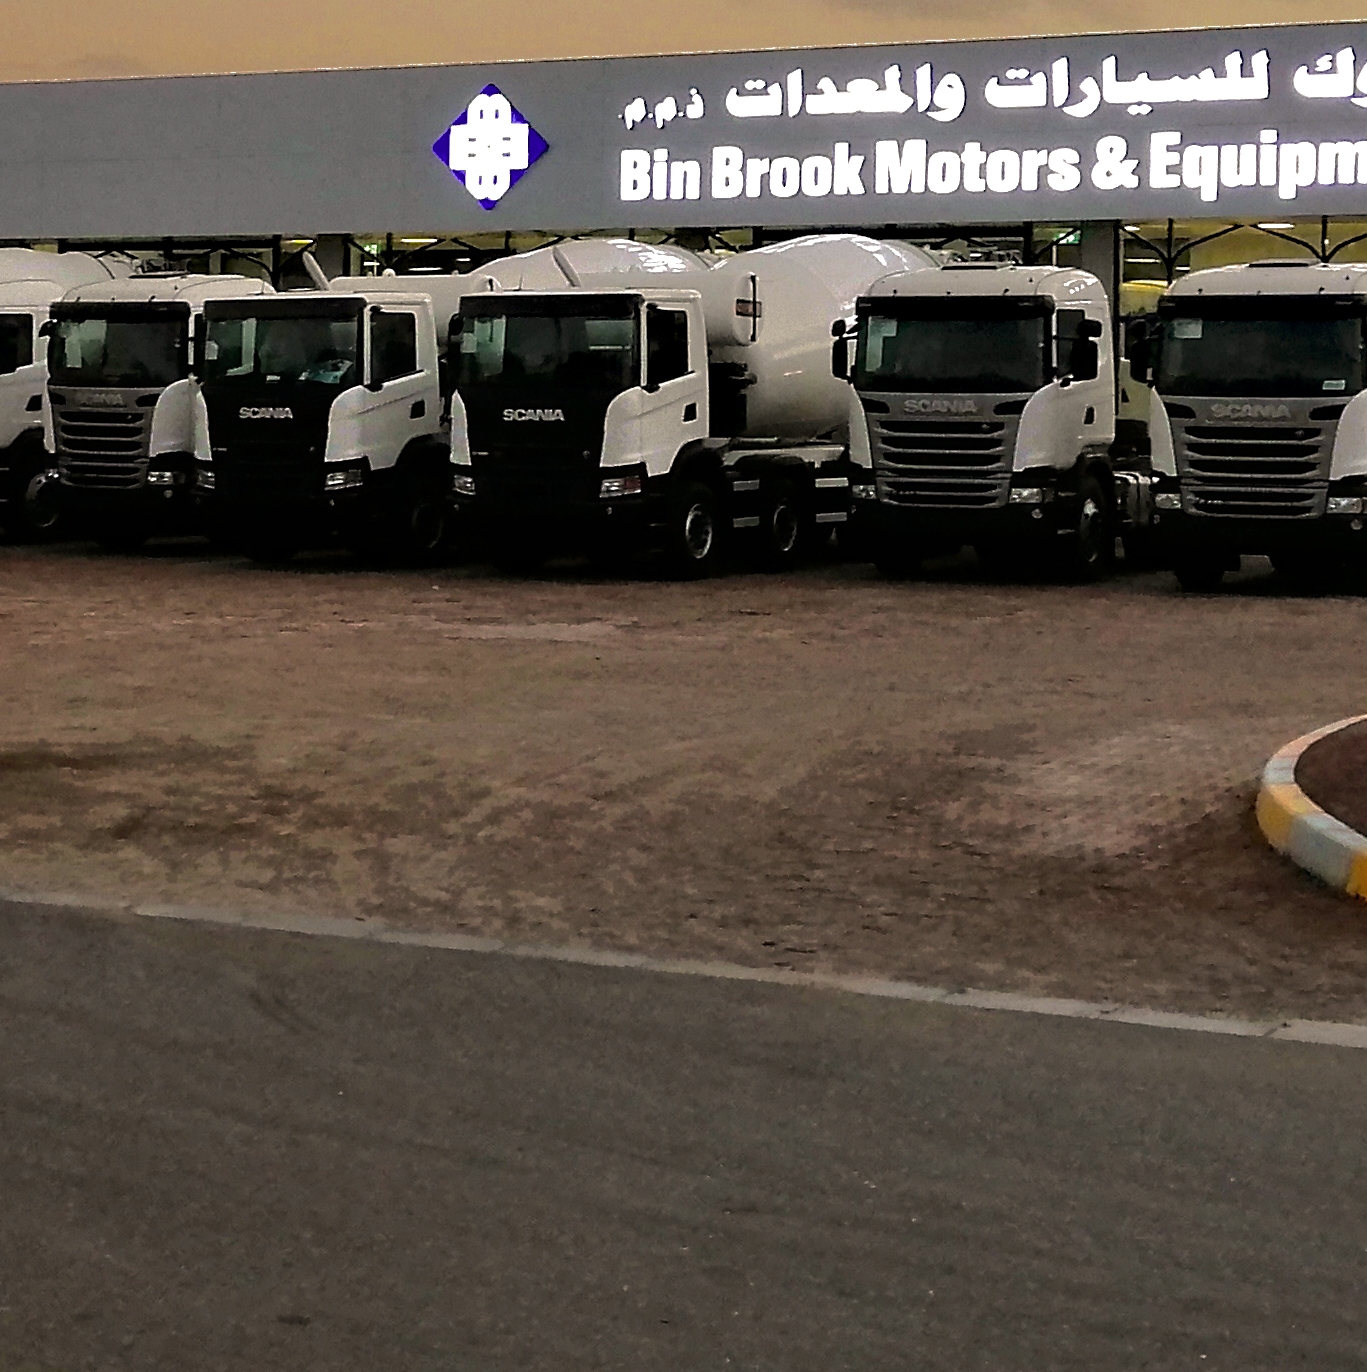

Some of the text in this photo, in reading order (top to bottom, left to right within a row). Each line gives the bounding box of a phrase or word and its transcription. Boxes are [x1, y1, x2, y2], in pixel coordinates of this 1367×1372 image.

[725, 62, 966, 122] والمعدات
[984, 49, 1270, 118] للسيارات
[619, 147, 701, 201] Bin
[711, 145, 866, 199] Brook
[875, 138, 1081, 195] Motors
[1090, 134, 1140, 190] &
[238, 406, 294, 419] SCANIA
[502, 408, 565, 422] SCANIA
[903, 399, 978, 414] SCANIA
